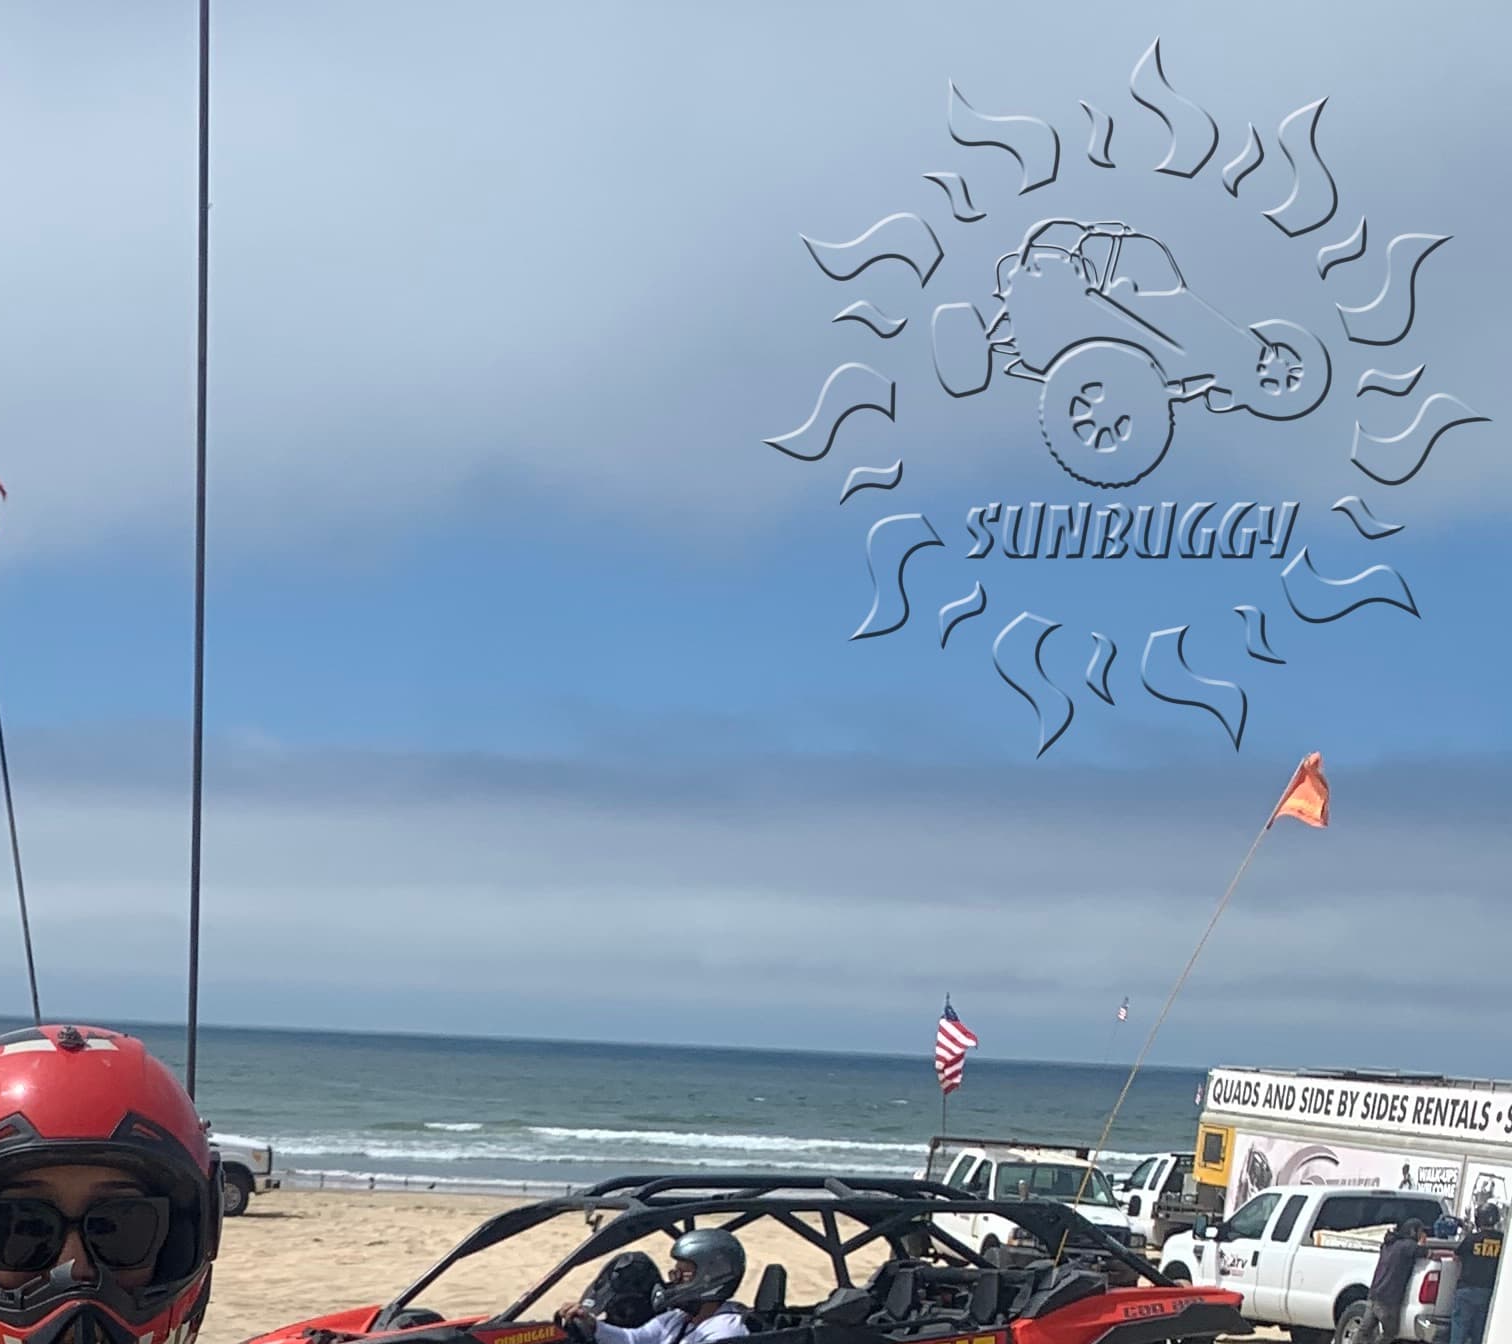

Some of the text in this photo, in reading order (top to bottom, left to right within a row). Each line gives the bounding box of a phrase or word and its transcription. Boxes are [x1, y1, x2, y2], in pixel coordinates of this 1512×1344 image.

[1212, 1078, 1260, 1107] QUADS
[1262, 1083, 1296, 1111] AND
[1299, 1087, 1333, 1116] SIDE
[1337, 1091, 1360, 1119] BY
[1361, 1092, 1409, 1122] SIDES
[1412, 1096, 1492, 1131] RENTALS
